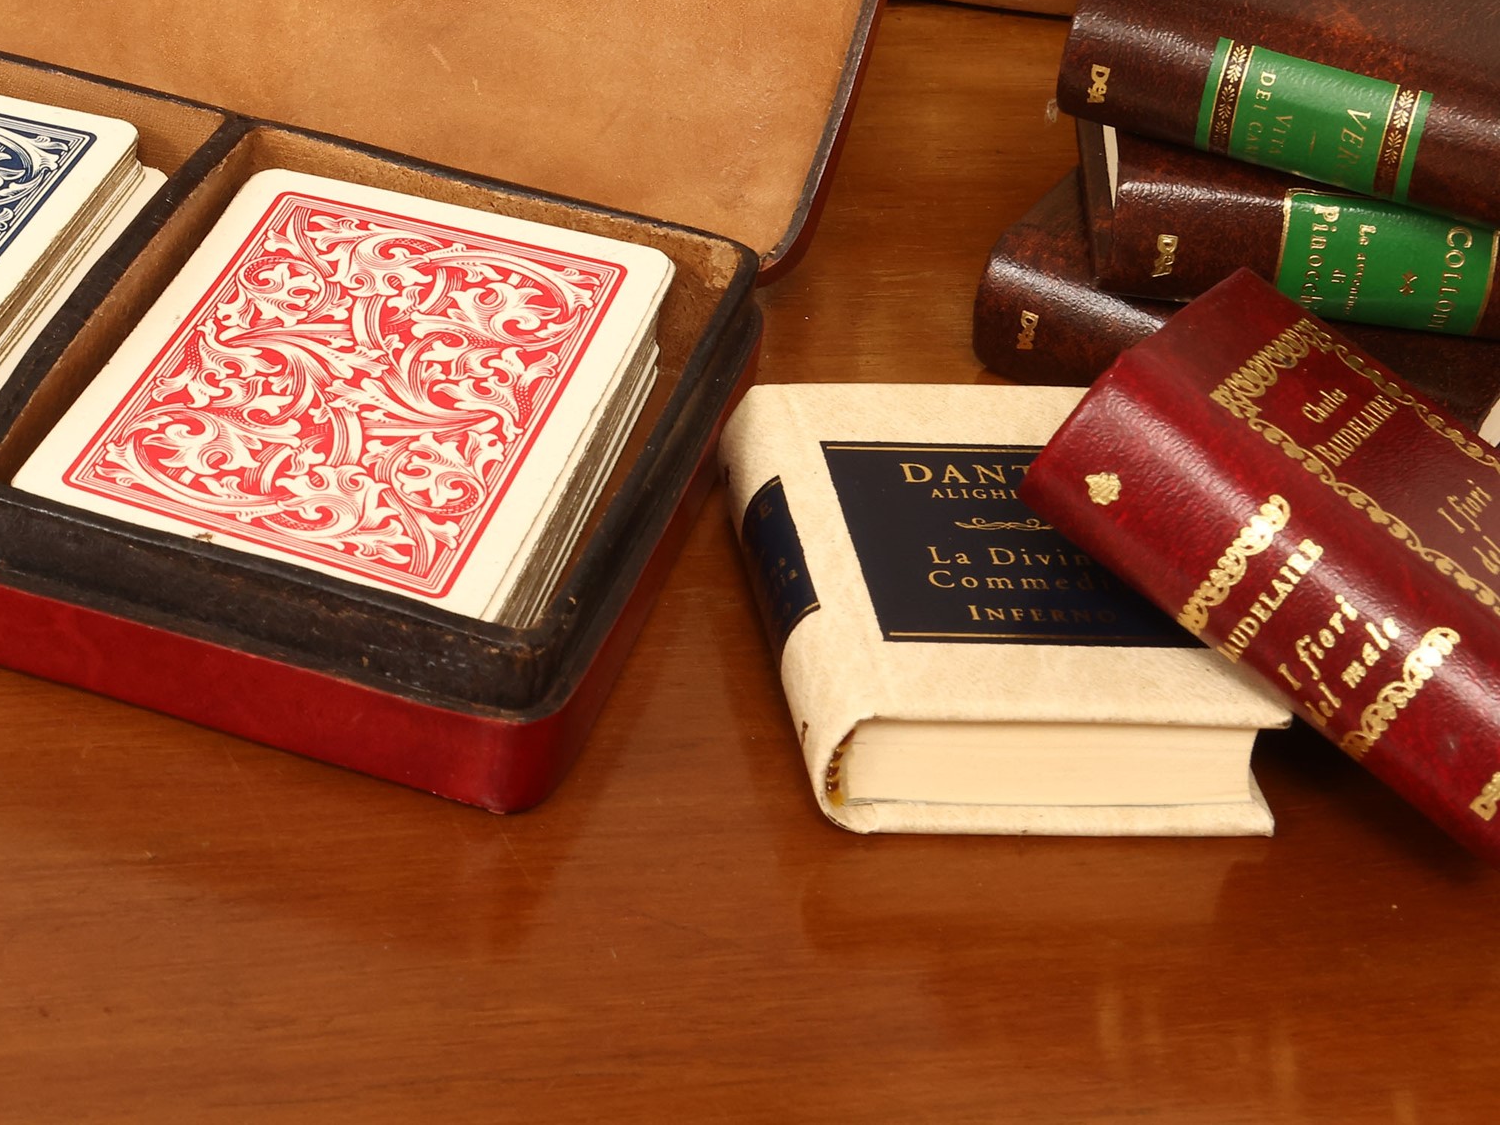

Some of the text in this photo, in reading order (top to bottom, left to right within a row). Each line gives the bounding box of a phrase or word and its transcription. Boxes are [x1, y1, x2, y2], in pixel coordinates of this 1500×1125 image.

[1253, 71, 1277, 111] DEI
[1300, 204, 1341, 311] Pinocch
[1331, 269, 1347, 284] di
[1427, 226, 1473, 328] COLLODI
[1302, 388, 1349, 424] Charles
[1313, 394, 1399, 467] BAUDELAIRE
[900, 462, 1031, 485] DANT
[931, 487, 1019, 501] ALIGHI
[1437, 479, 1493, 535] I fiori
[927, 546, 1092, 567] La Divin
[967, 604, 1118, 624] INFERNO
[1278, 594, 1359, 691] I fiori
[1340, 616, 1401, 690] male
